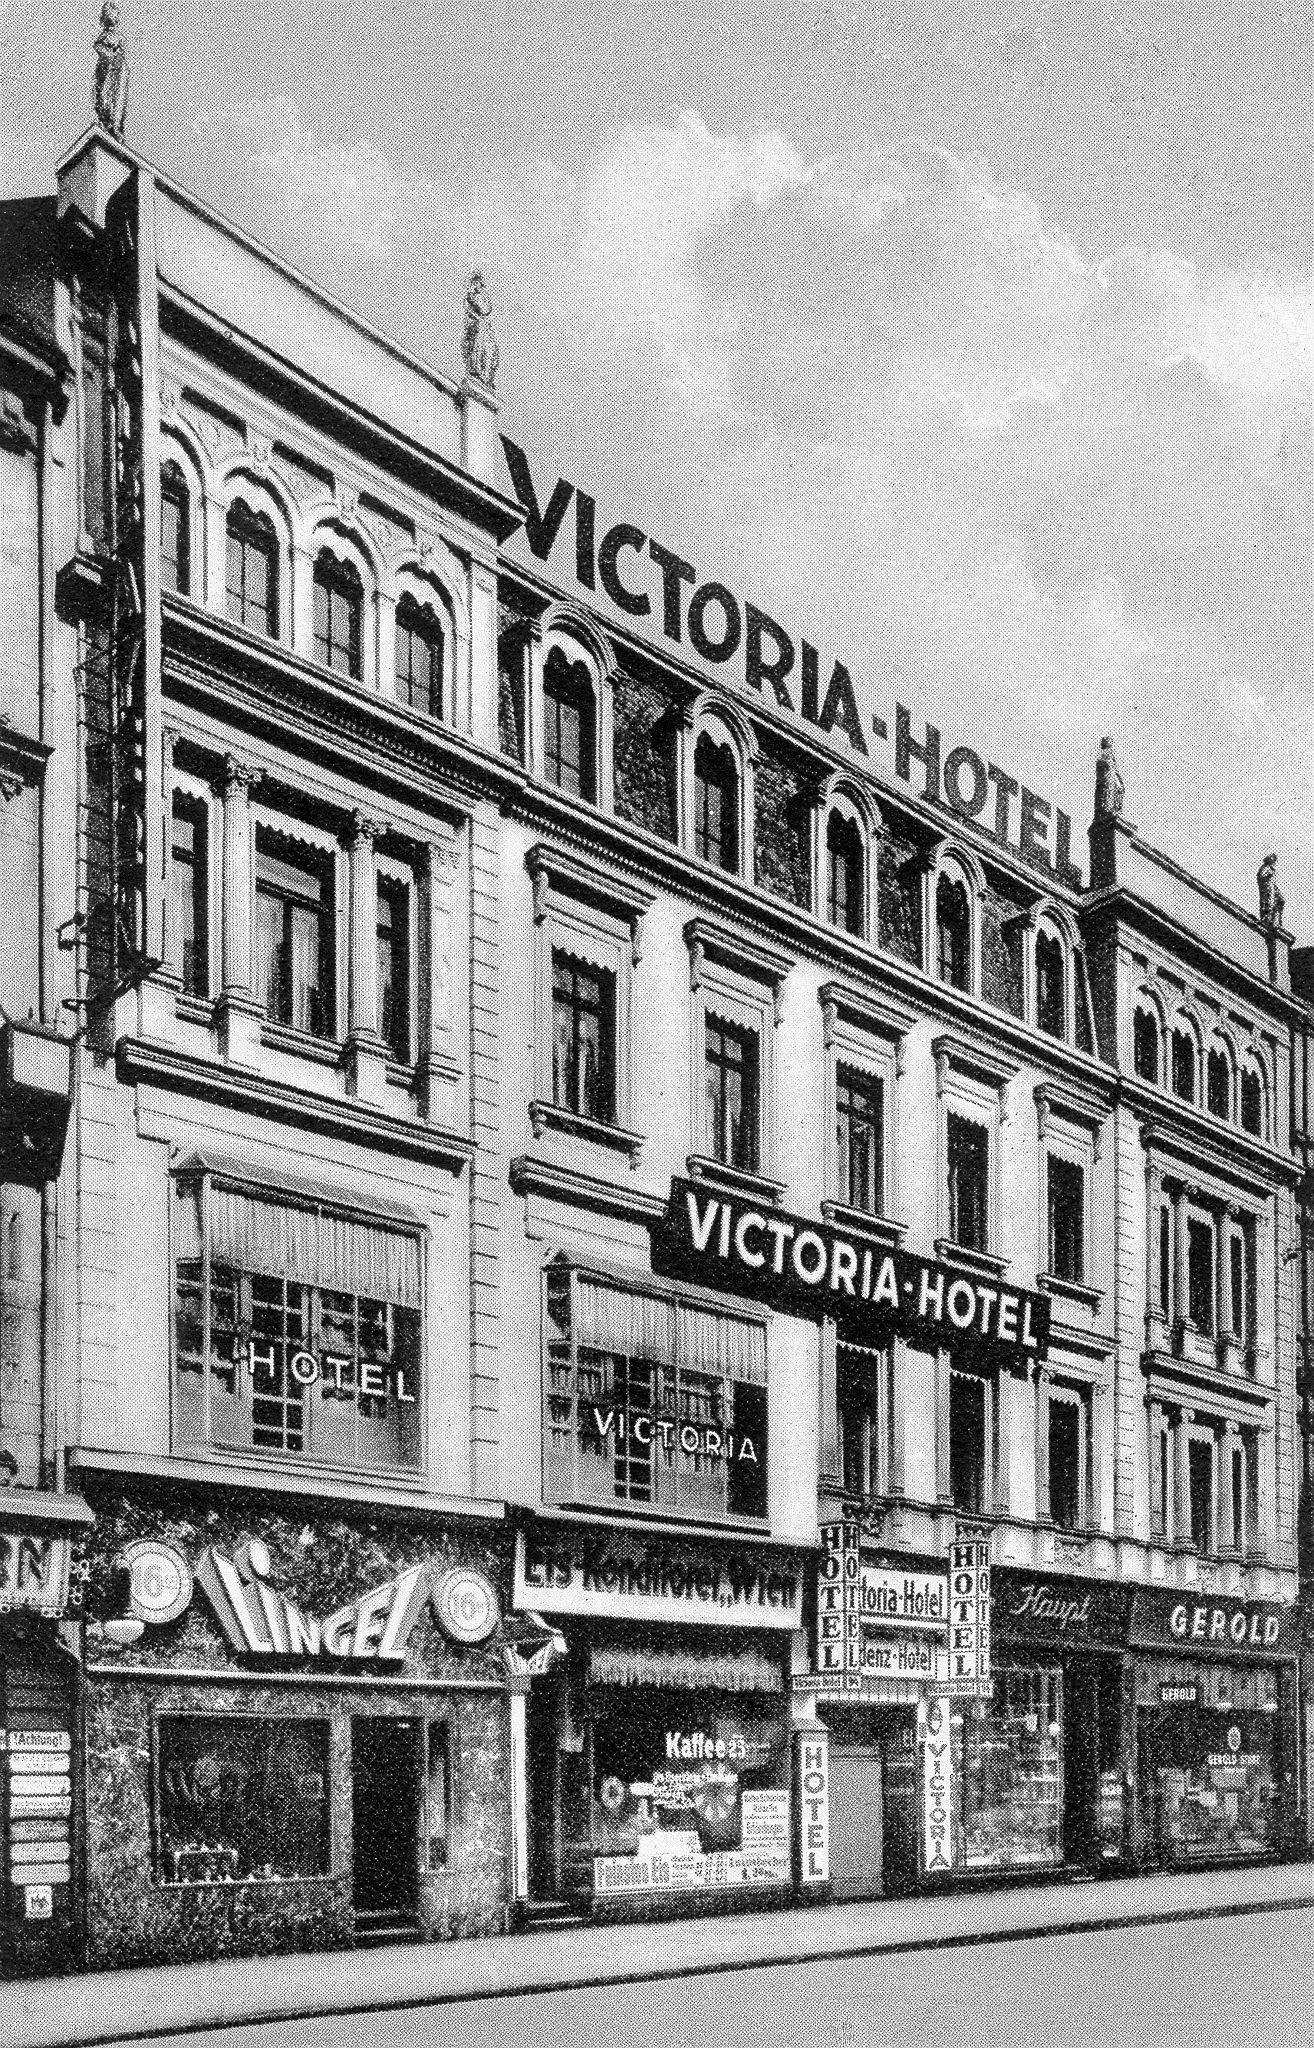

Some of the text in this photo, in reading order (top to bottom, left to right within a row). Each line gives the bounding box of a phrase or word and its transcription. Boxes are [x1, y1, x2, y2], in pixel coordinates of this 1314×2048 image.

[247, 1340, 416, 1403] HOTEL
[593, 1406, 760, 1464] VICTORIA
[821, 1526, 842, 1669] HOTEL
[846, 1526, 859, 1669] HOTEL
[953, 1546, 974, 1676] HOTEL
[979, 1546, 990, 1676] HOTEL
[1009, 1584, 1092, 1630] Haupt
[1170, 1605, 1281, 1645] GEROLD
[1161, 1687, 1197, 1701] GEROLD
[665, 1731, 726, 1759] Kaffee
[804, 1745, 825, 1878] HOTEL
[928, 1744, 950, 1869] VICTORIA
